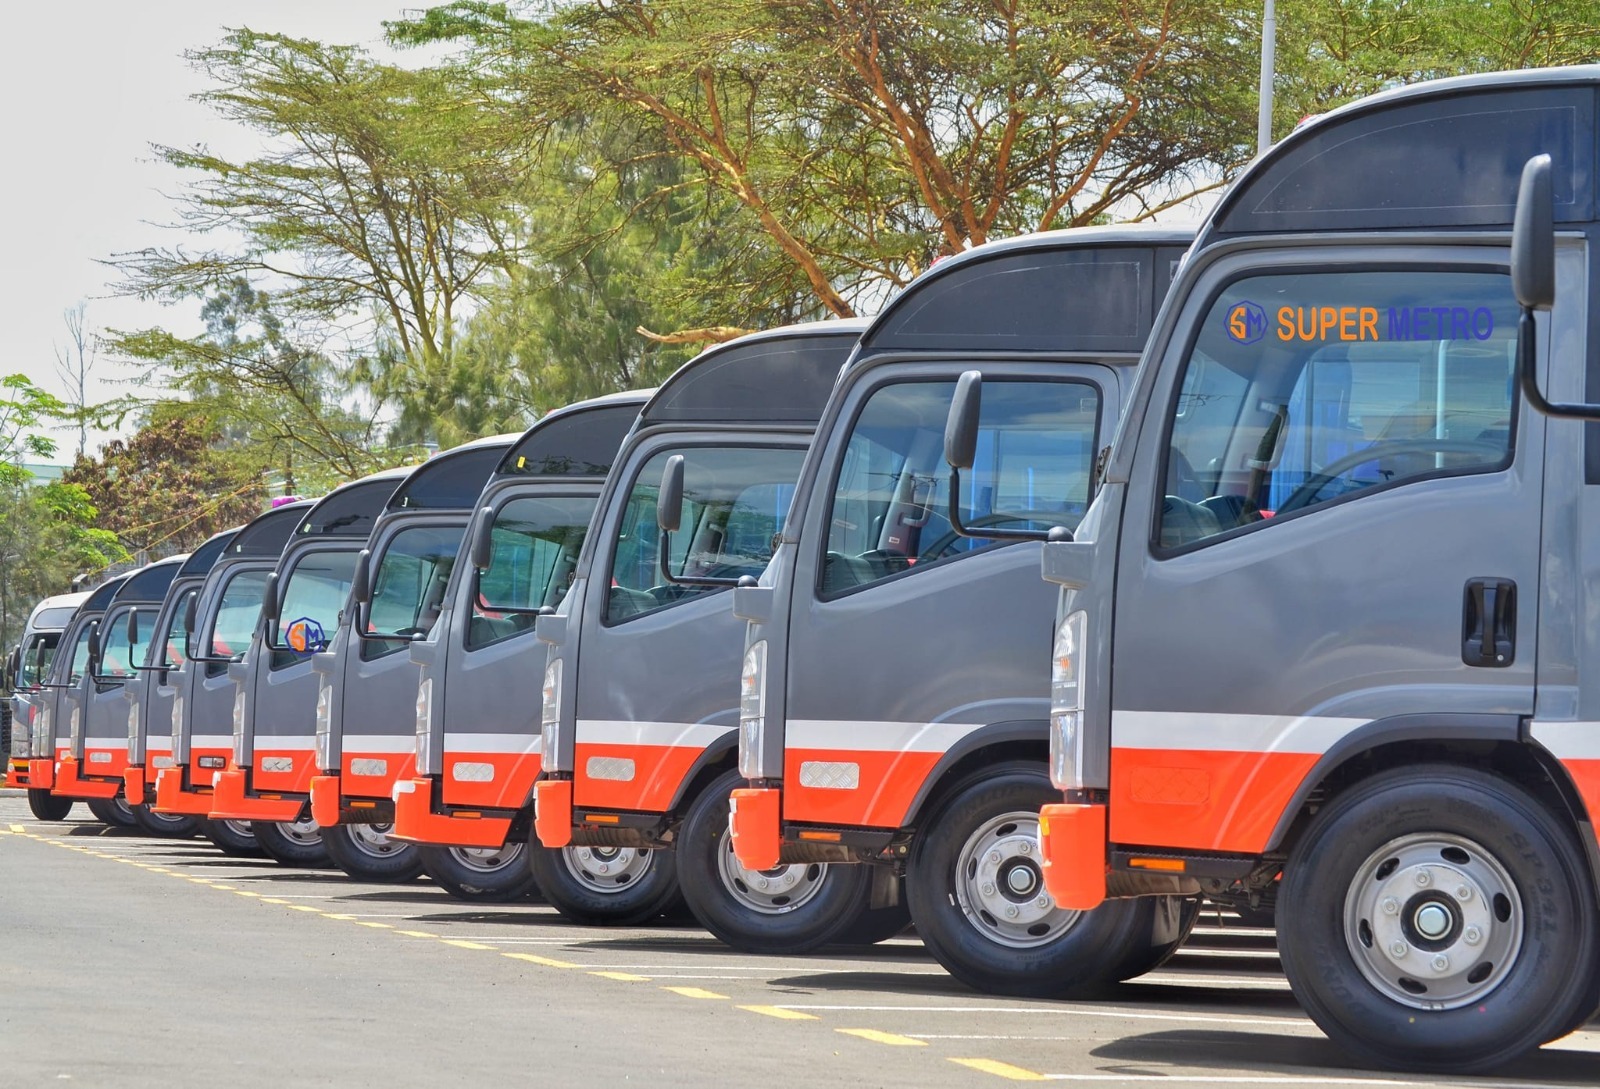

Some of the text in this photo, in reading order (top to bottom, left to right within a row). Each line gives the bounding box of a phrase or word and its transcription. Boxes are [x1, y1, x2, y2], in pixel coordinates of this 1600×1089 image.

[1228, 306, 1494, 341] SM SUPER METRO
[290, 622, 320, 653] SM
